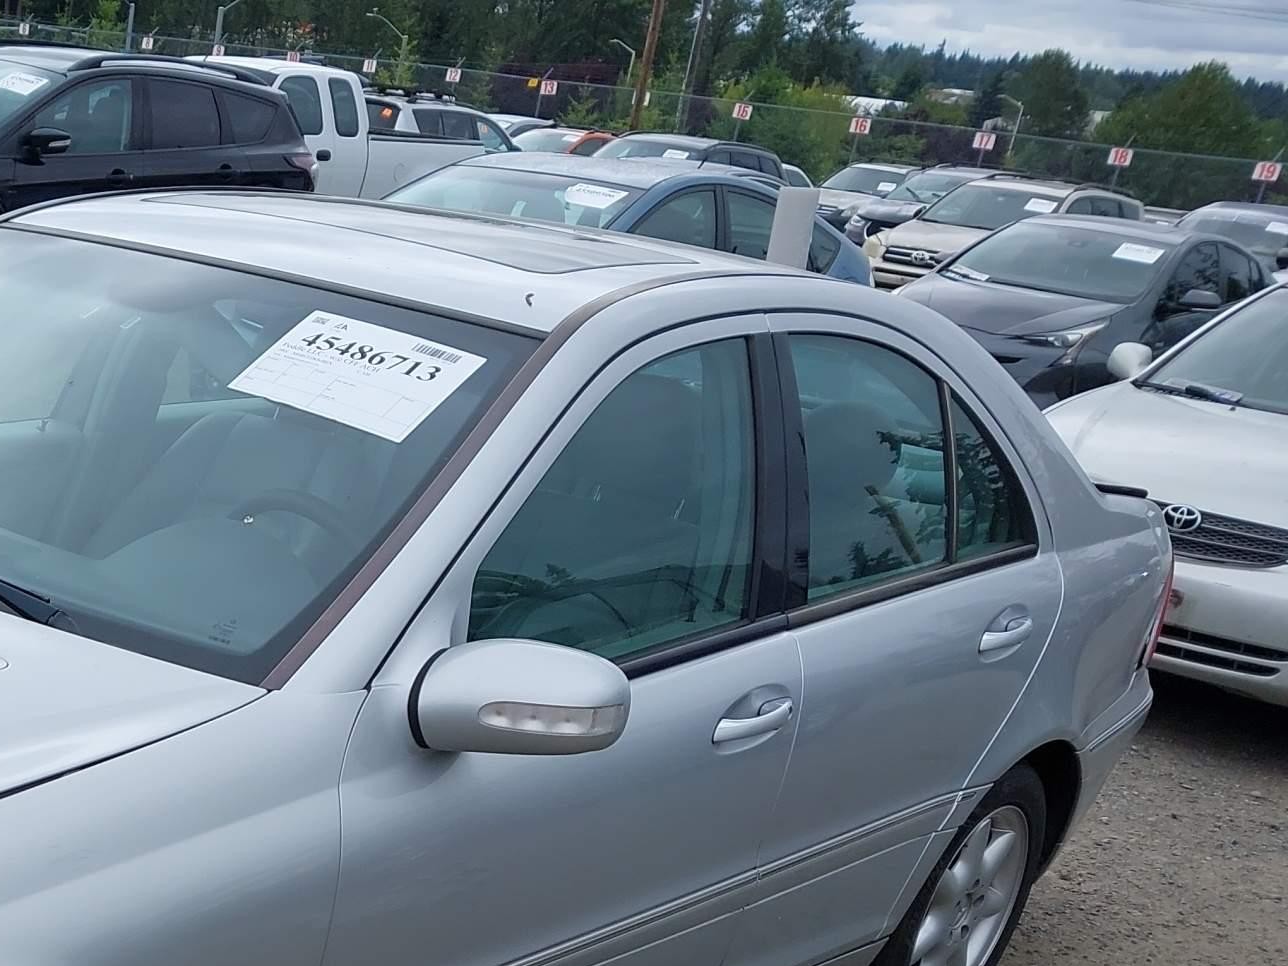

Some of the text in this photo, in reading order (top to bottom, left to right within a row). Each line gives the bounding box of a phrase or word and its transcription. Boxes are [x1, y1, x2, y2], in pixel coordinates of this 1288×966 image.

[366, 60, 375, 72] 11
[449, 69, 459, 82] 12
[544, 81, 556, 94] 13
[736, 103, 750, 119] 15
[853, 118, 868, 133] 16
[978, 133, 993, 149] 17
[1112, 148, 1129, 165] 18
[1257, 163, 1277, 179] 19
[301, 332, 443, 382] 45486713
